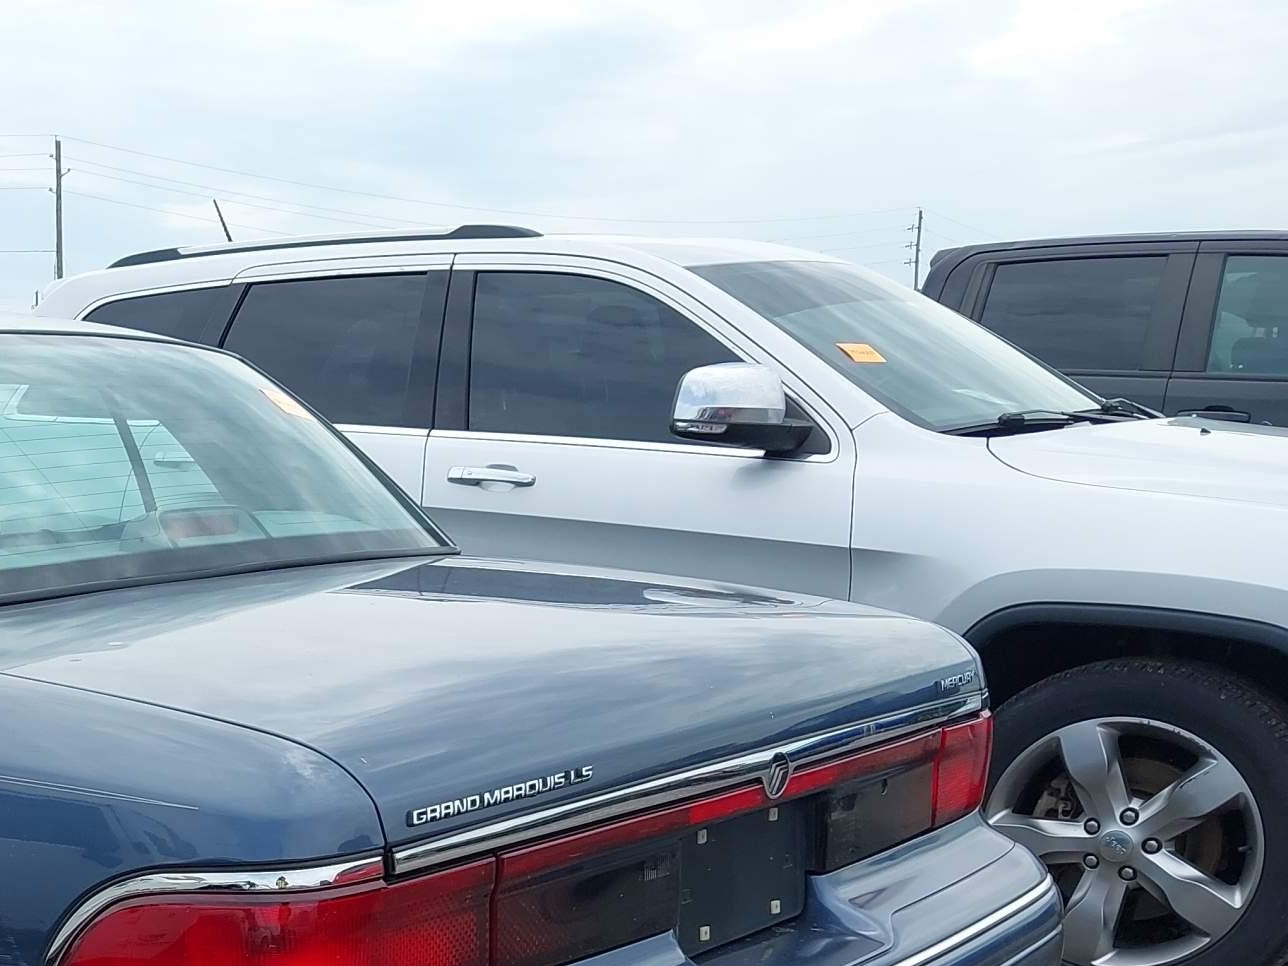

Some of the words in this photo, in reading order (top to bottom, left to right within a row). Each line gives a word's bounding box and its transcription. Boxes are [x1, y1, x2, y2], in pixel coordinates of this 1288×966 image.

[940, 669, 977, 691] MERCURY
[412, 795, 480, 825] GRAND
[483, 772, 565, 807] MARQUIS
[570, 765, 593, 785] LS
